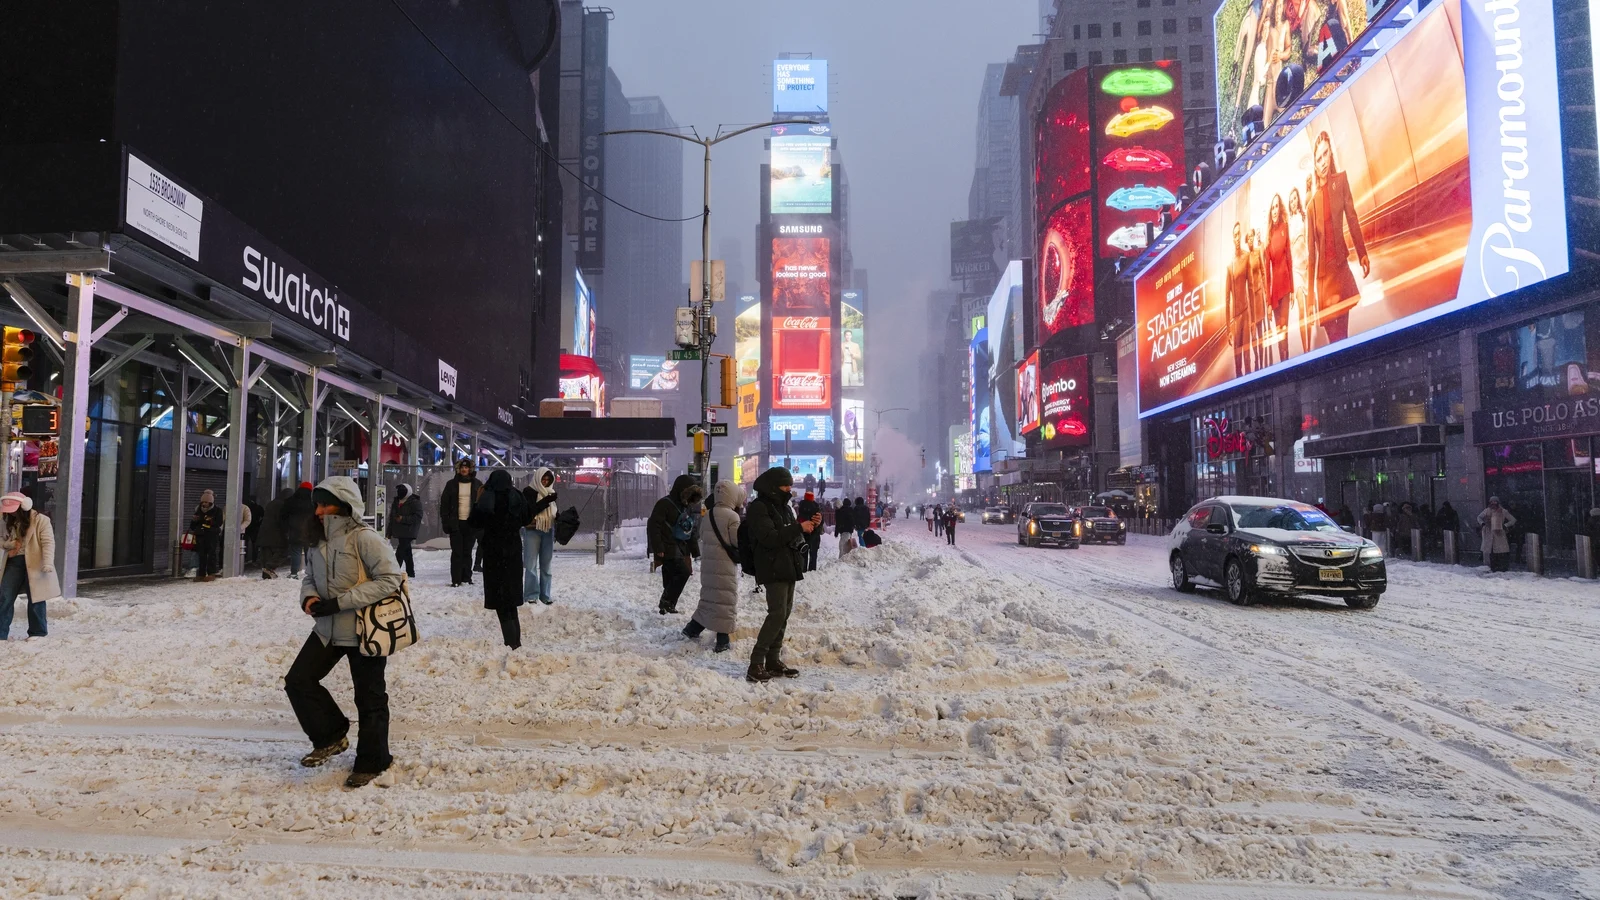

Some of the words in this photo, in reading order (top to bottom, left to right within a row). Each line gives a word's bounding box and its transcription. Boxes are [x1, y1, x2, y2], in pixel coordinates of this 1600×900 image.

[777, 77, 815, 85] SOMETHING
[1480, 0, 1547, 299] Paramount
[149, 172, 161, 194] 1535
[161, 179, 187, 210] BROADWAY
[583, 136, 600, 252] SQUARE
[1181, 251, 1195, 269] FUTURE
[808, 271, 827, 279] good
[242, 245, 337, 335] swatch
[1146, 280, 1209, 341] STARFLEET
[783, 316, 820, 329] Coca-Cola
[1151, 310, 1205, 362] ACADEMY
[683, 352, 692, 360] 45
[1175, 357, 1187, 370] SERIES
[1159, 372, 1170, 388] NOW
[1170, 362, 1197, 383] STREAMING
[49, 411, 58, 430] 3
[1492, 410, 1518, 429] U.S.
[1521, 403, 1569, 425] POLO
[1572, 398, 1600, 420] AS
[1558, 422, 1576, 432] 1890
[187, 442, 228, 460] swatch
